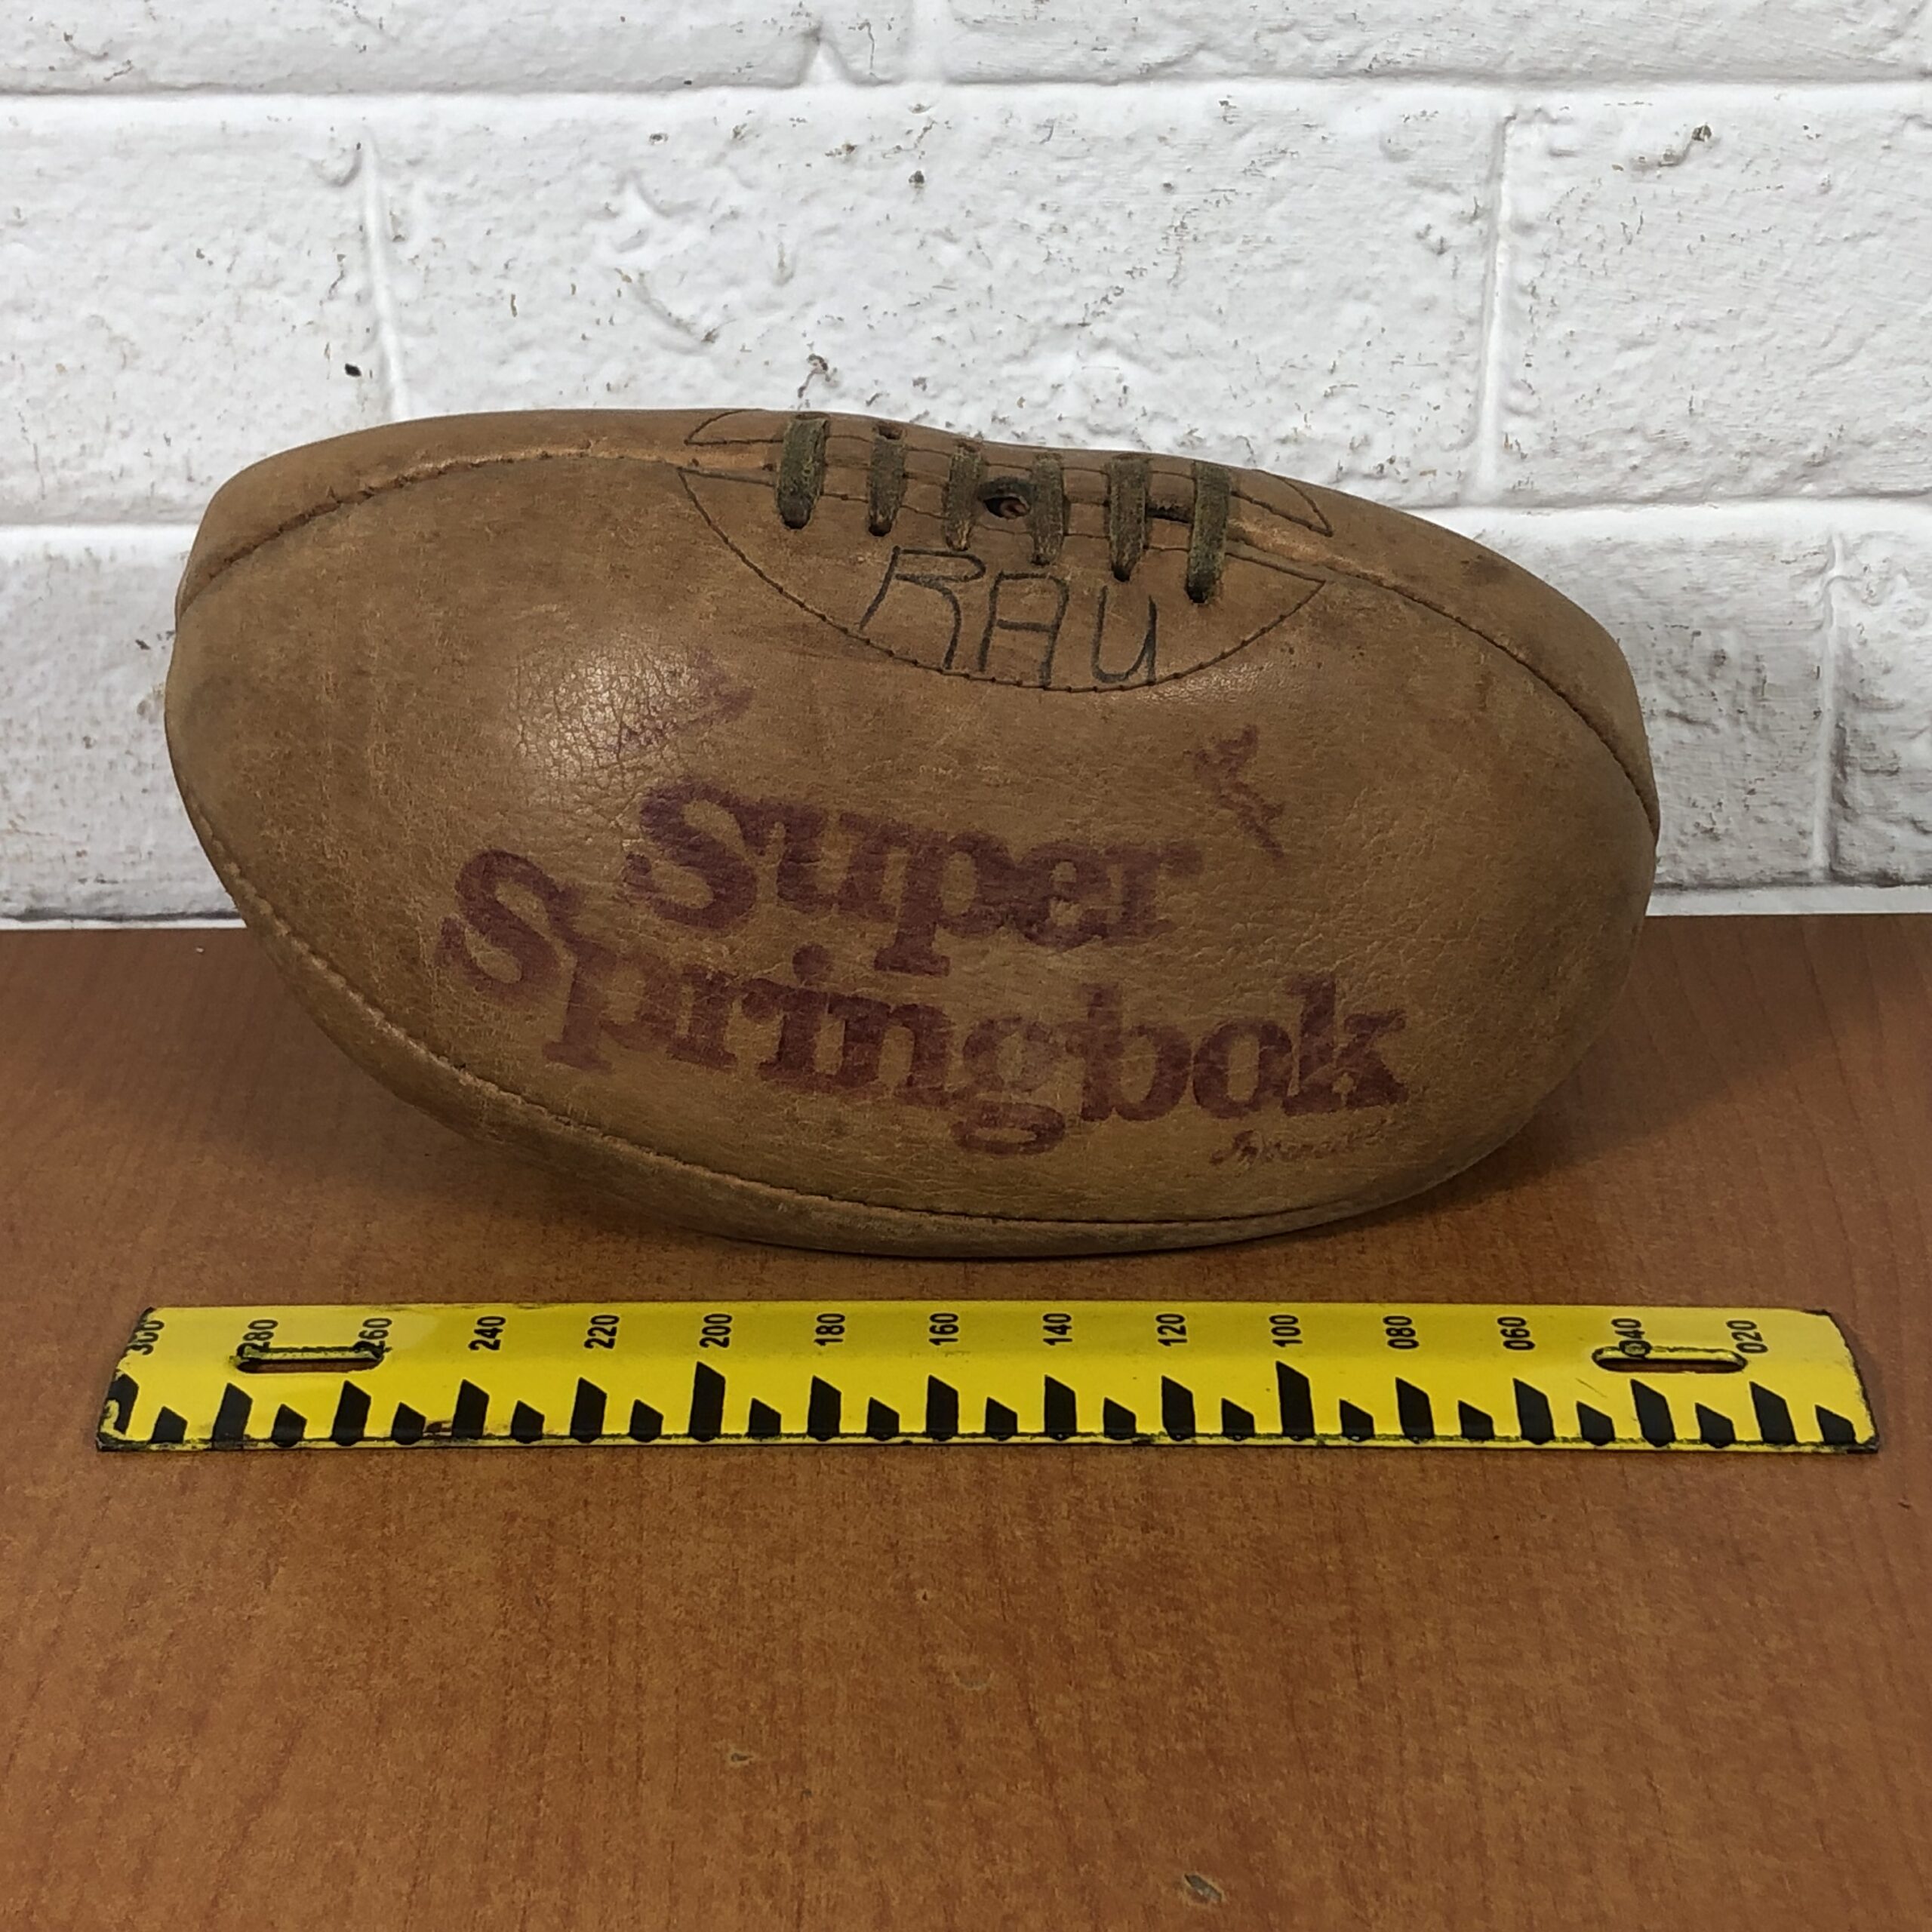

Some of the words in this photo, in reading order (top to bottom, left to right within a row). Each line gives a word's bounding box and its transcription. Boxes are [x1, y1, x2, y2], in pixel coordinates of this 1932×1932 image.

[858, 545, 1158, 686] RAU
[616, 776, 1205, 978] Super
[435, 848, 1411, 1157] Springbok
[468, 1315, 506, 1351] 240
[583, 1314, 620, 1349] 220
[698, 1313, 733, 1349] 200
[814, 1313, 846, 1346] 180
[928, 1312, 959, 1346] 160
[1042, 1312, 1073, 1346] 140
[1155, 1313, 1188, 1347] 120
[1268, 1314, 1303, 1348] 100
[1382, 1315, 1420, 1350] 080
[1497, 1316, 1536, 1351] 060
[1611, 1318, 1653, 1358] 040
[1725, 1319, 1768, 1354] 020
